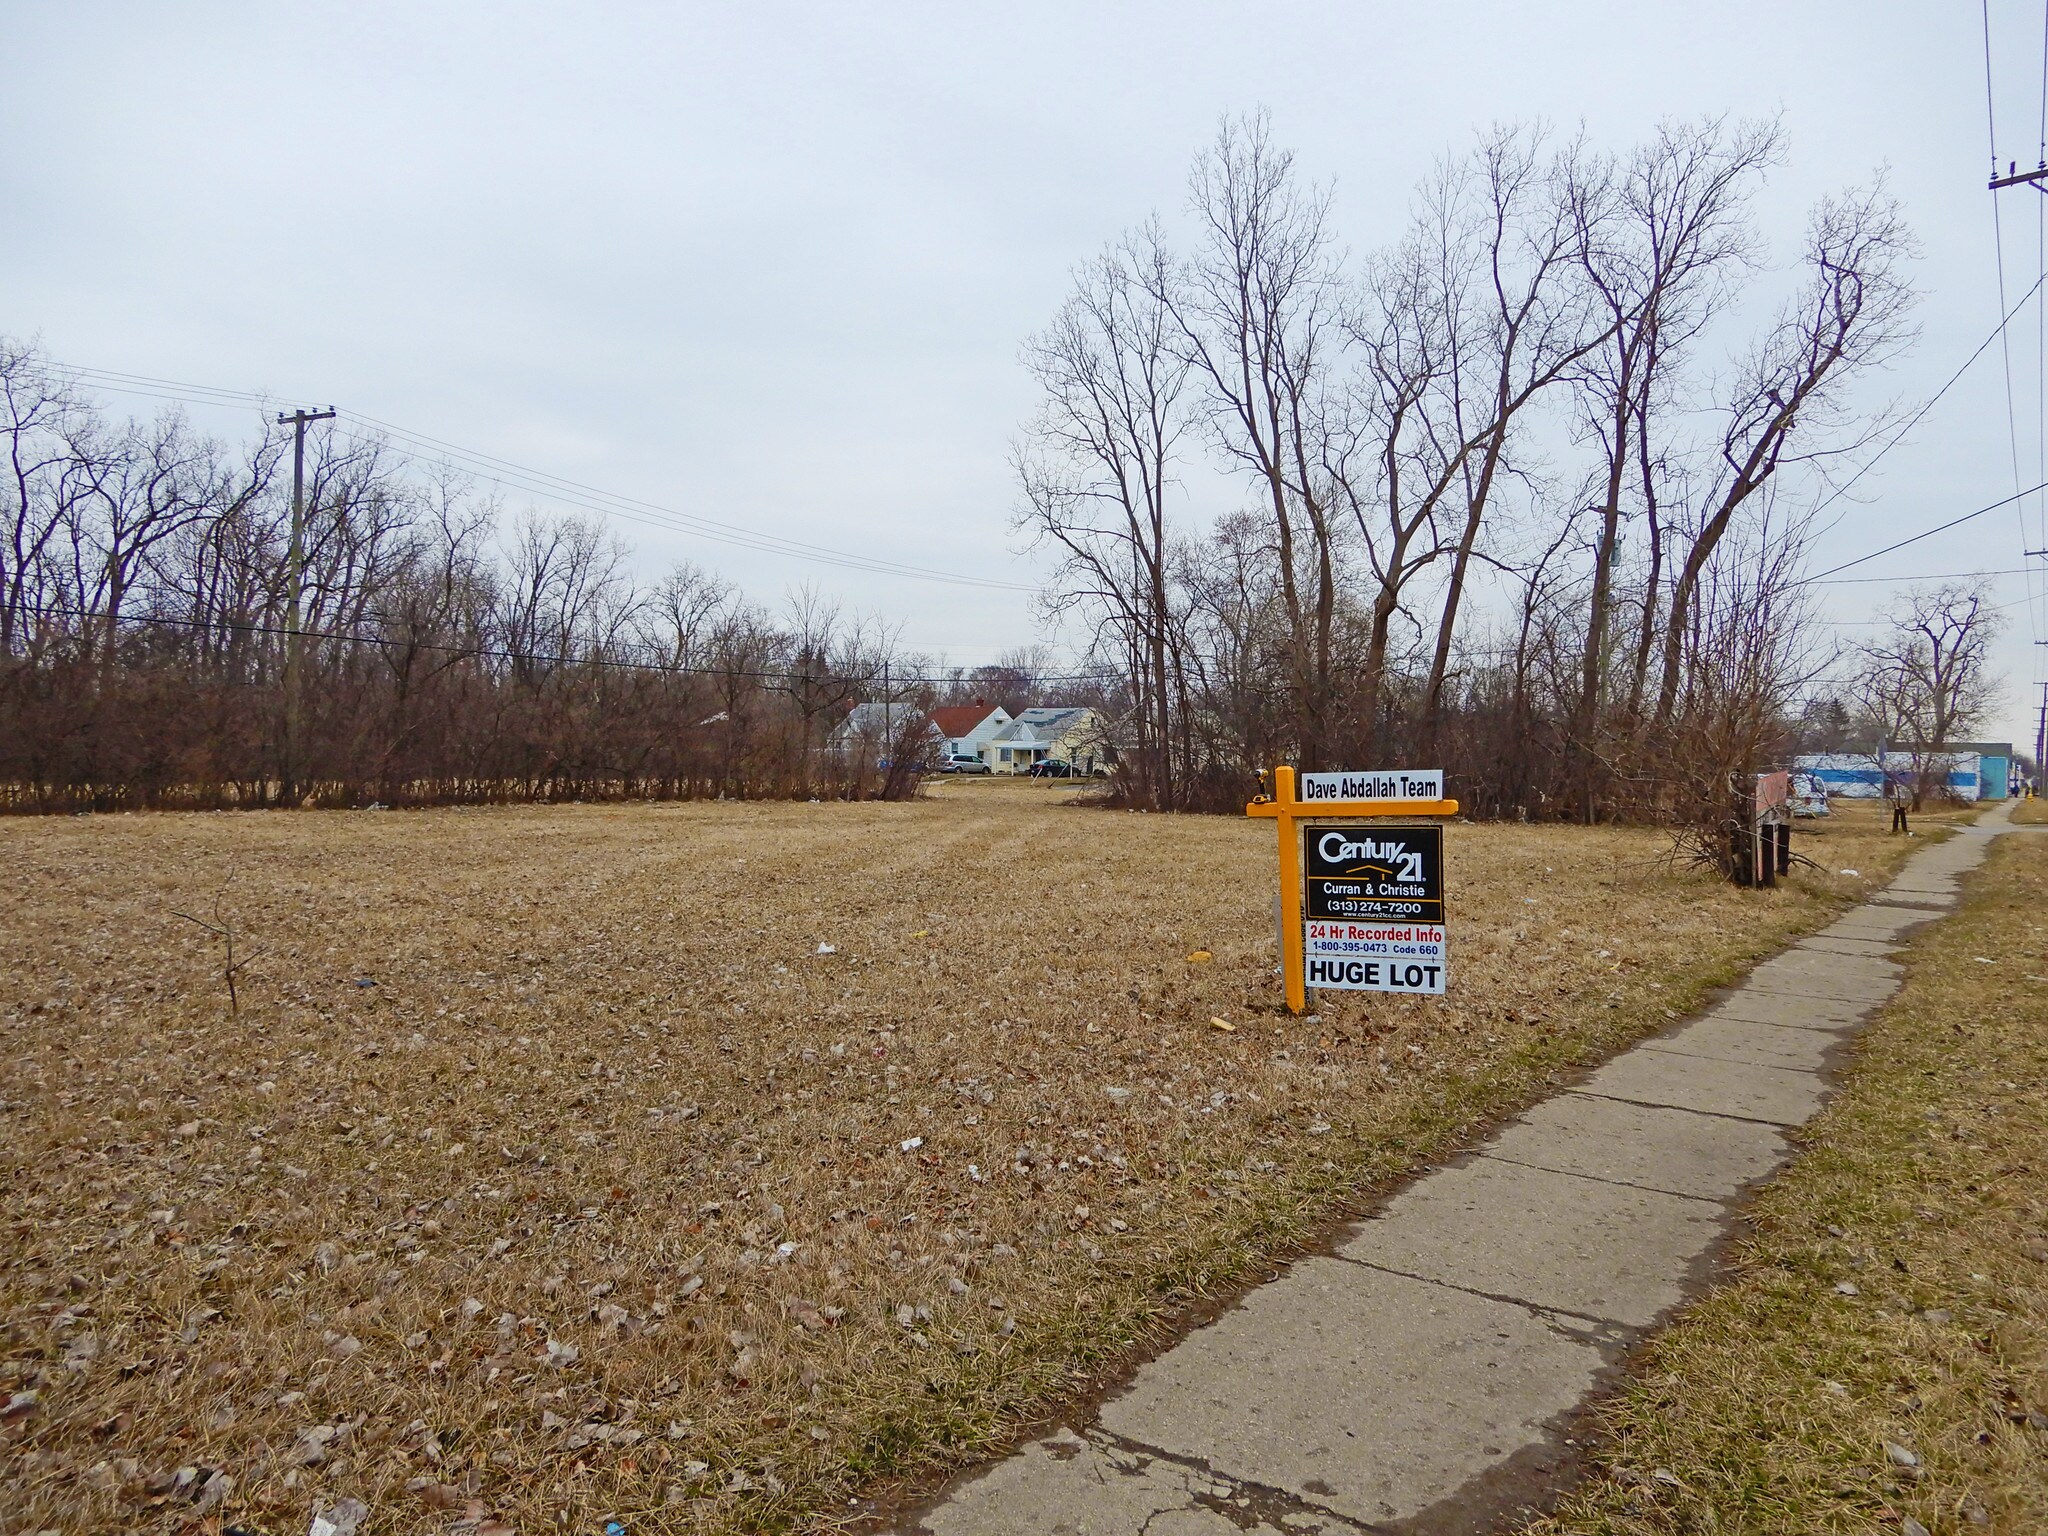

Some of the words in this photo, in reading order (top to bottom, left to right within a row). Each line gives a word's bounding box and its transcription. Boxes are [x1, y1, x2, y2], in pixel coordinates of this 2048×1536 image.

[1307, 778, 1336, 799] Dave
[1341, 776, 1396, 798] Abdallah
[1400, 776, 1437, 797] Team
[1318, 832, 1406, 864] Century
[1396, 852, 1422, 882] 21
[1323, 882, 1360, 895] Curran
[1365, 884, 1374, 895] &
[1379, 883, 1425, 897] Christie
[1327, 900, 1358, 912] (313)
[1359, 901, 1422, 914] 274-7200
[1342, 912, 1406, 920] www.century21cc.com
[1310, 925, 1326, 939] 24
[1329, 925, 1345, 940] Hr
[1348, 926, 1411, 942] Recorded
[1416, 928, 1442, 943] Info
[1313, 941, 1388, 953] 1-800-395-0473
[1393, 945, 1416, 955] Code
[1419, 945, 1439, 955] 660
[1309, 960, 1380, 985] HUGE
[1389, 963, 1441, 988] LOT
